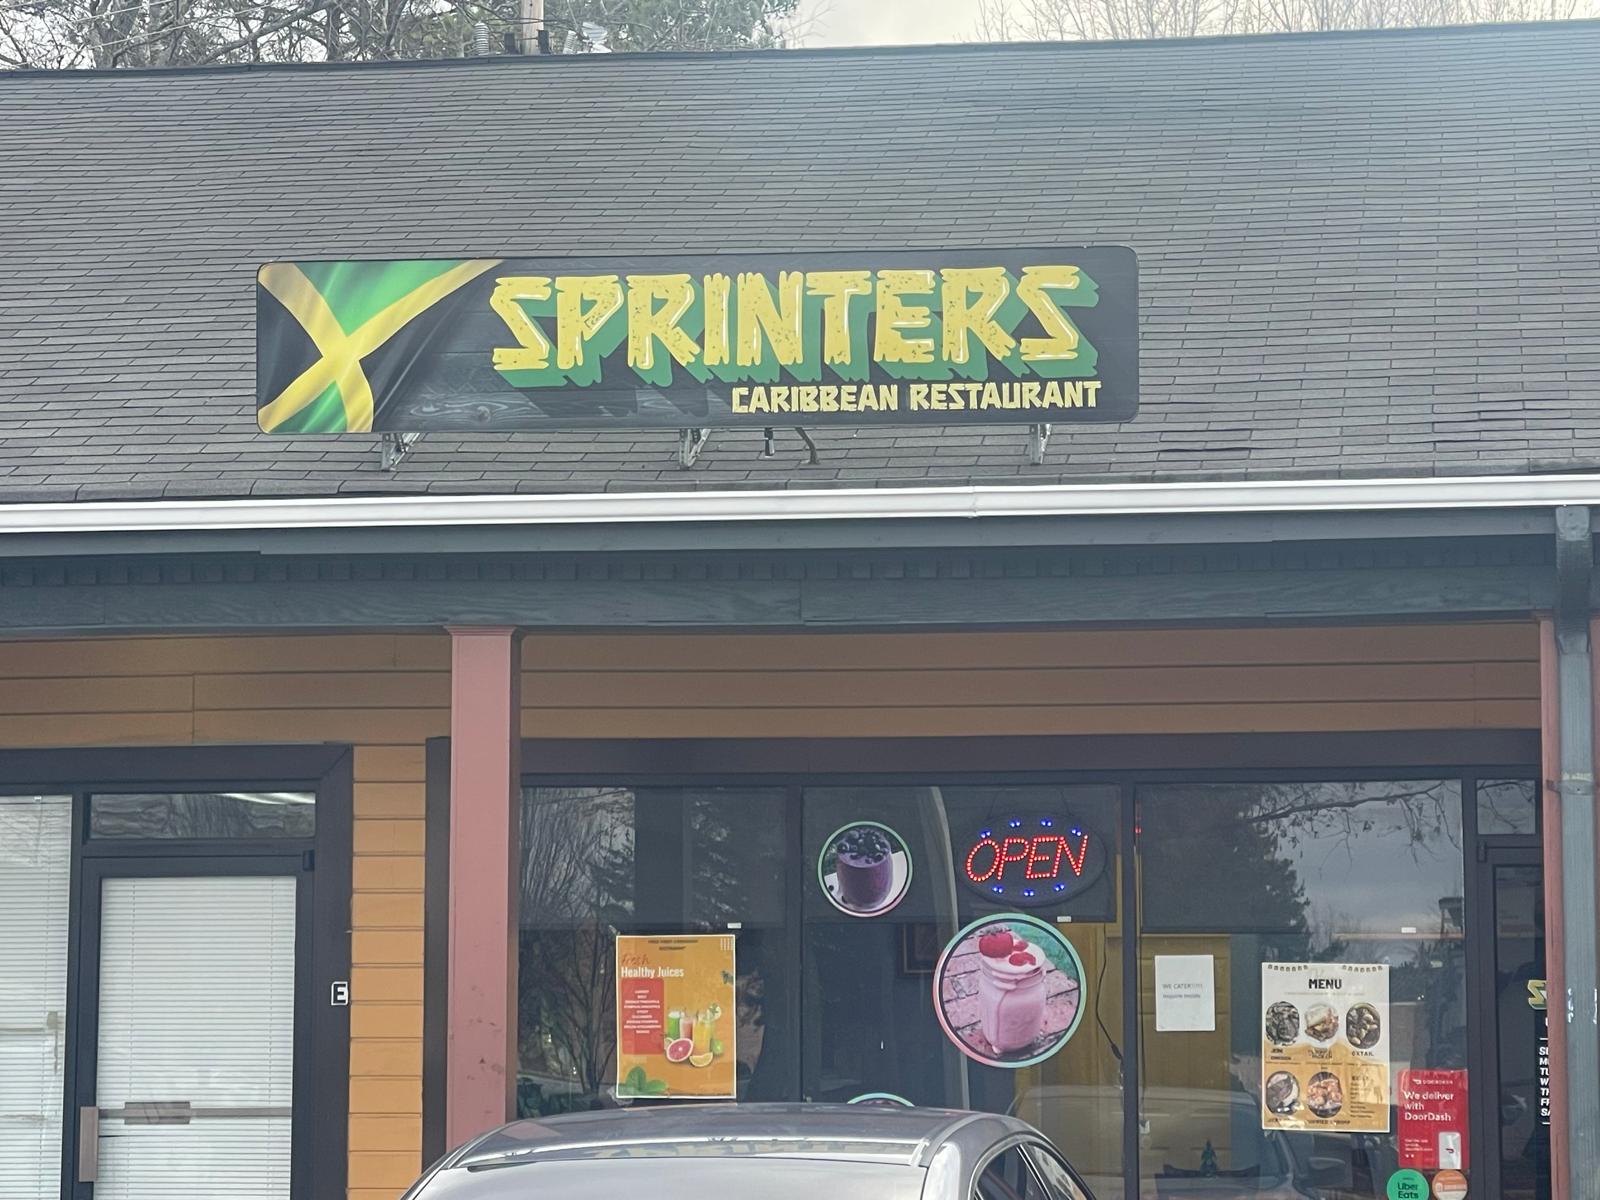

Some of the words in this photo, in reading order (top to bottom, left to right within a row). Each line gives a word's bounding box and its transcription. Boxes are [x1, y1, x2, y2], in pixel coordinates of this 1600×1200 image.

[489, 264, 1081, 372] SPRINTERS
[732, 384, 898, 414] CARIBBEAN
[909, 381, 1102, 411] RESTAURANT
[965, 833, 1089, 883] OPEN
[621, 966, 656, 979] Healthy
[657, 966, 685, 978] Juices
[1308, 979, 1343, 990] MENU
[333, 983, 348, 1004] E
[1403, 1091, 1420, 1100] We
[1422, 1091, 1454, 1100] deliver
[1404, 1101, 1425, 1110] with
[1404, 1112, 1452, 1121] DoorDash
[1397, 1182, 1418, 1191] Uber
[1397, 1190, 1419, 1199] Eats
